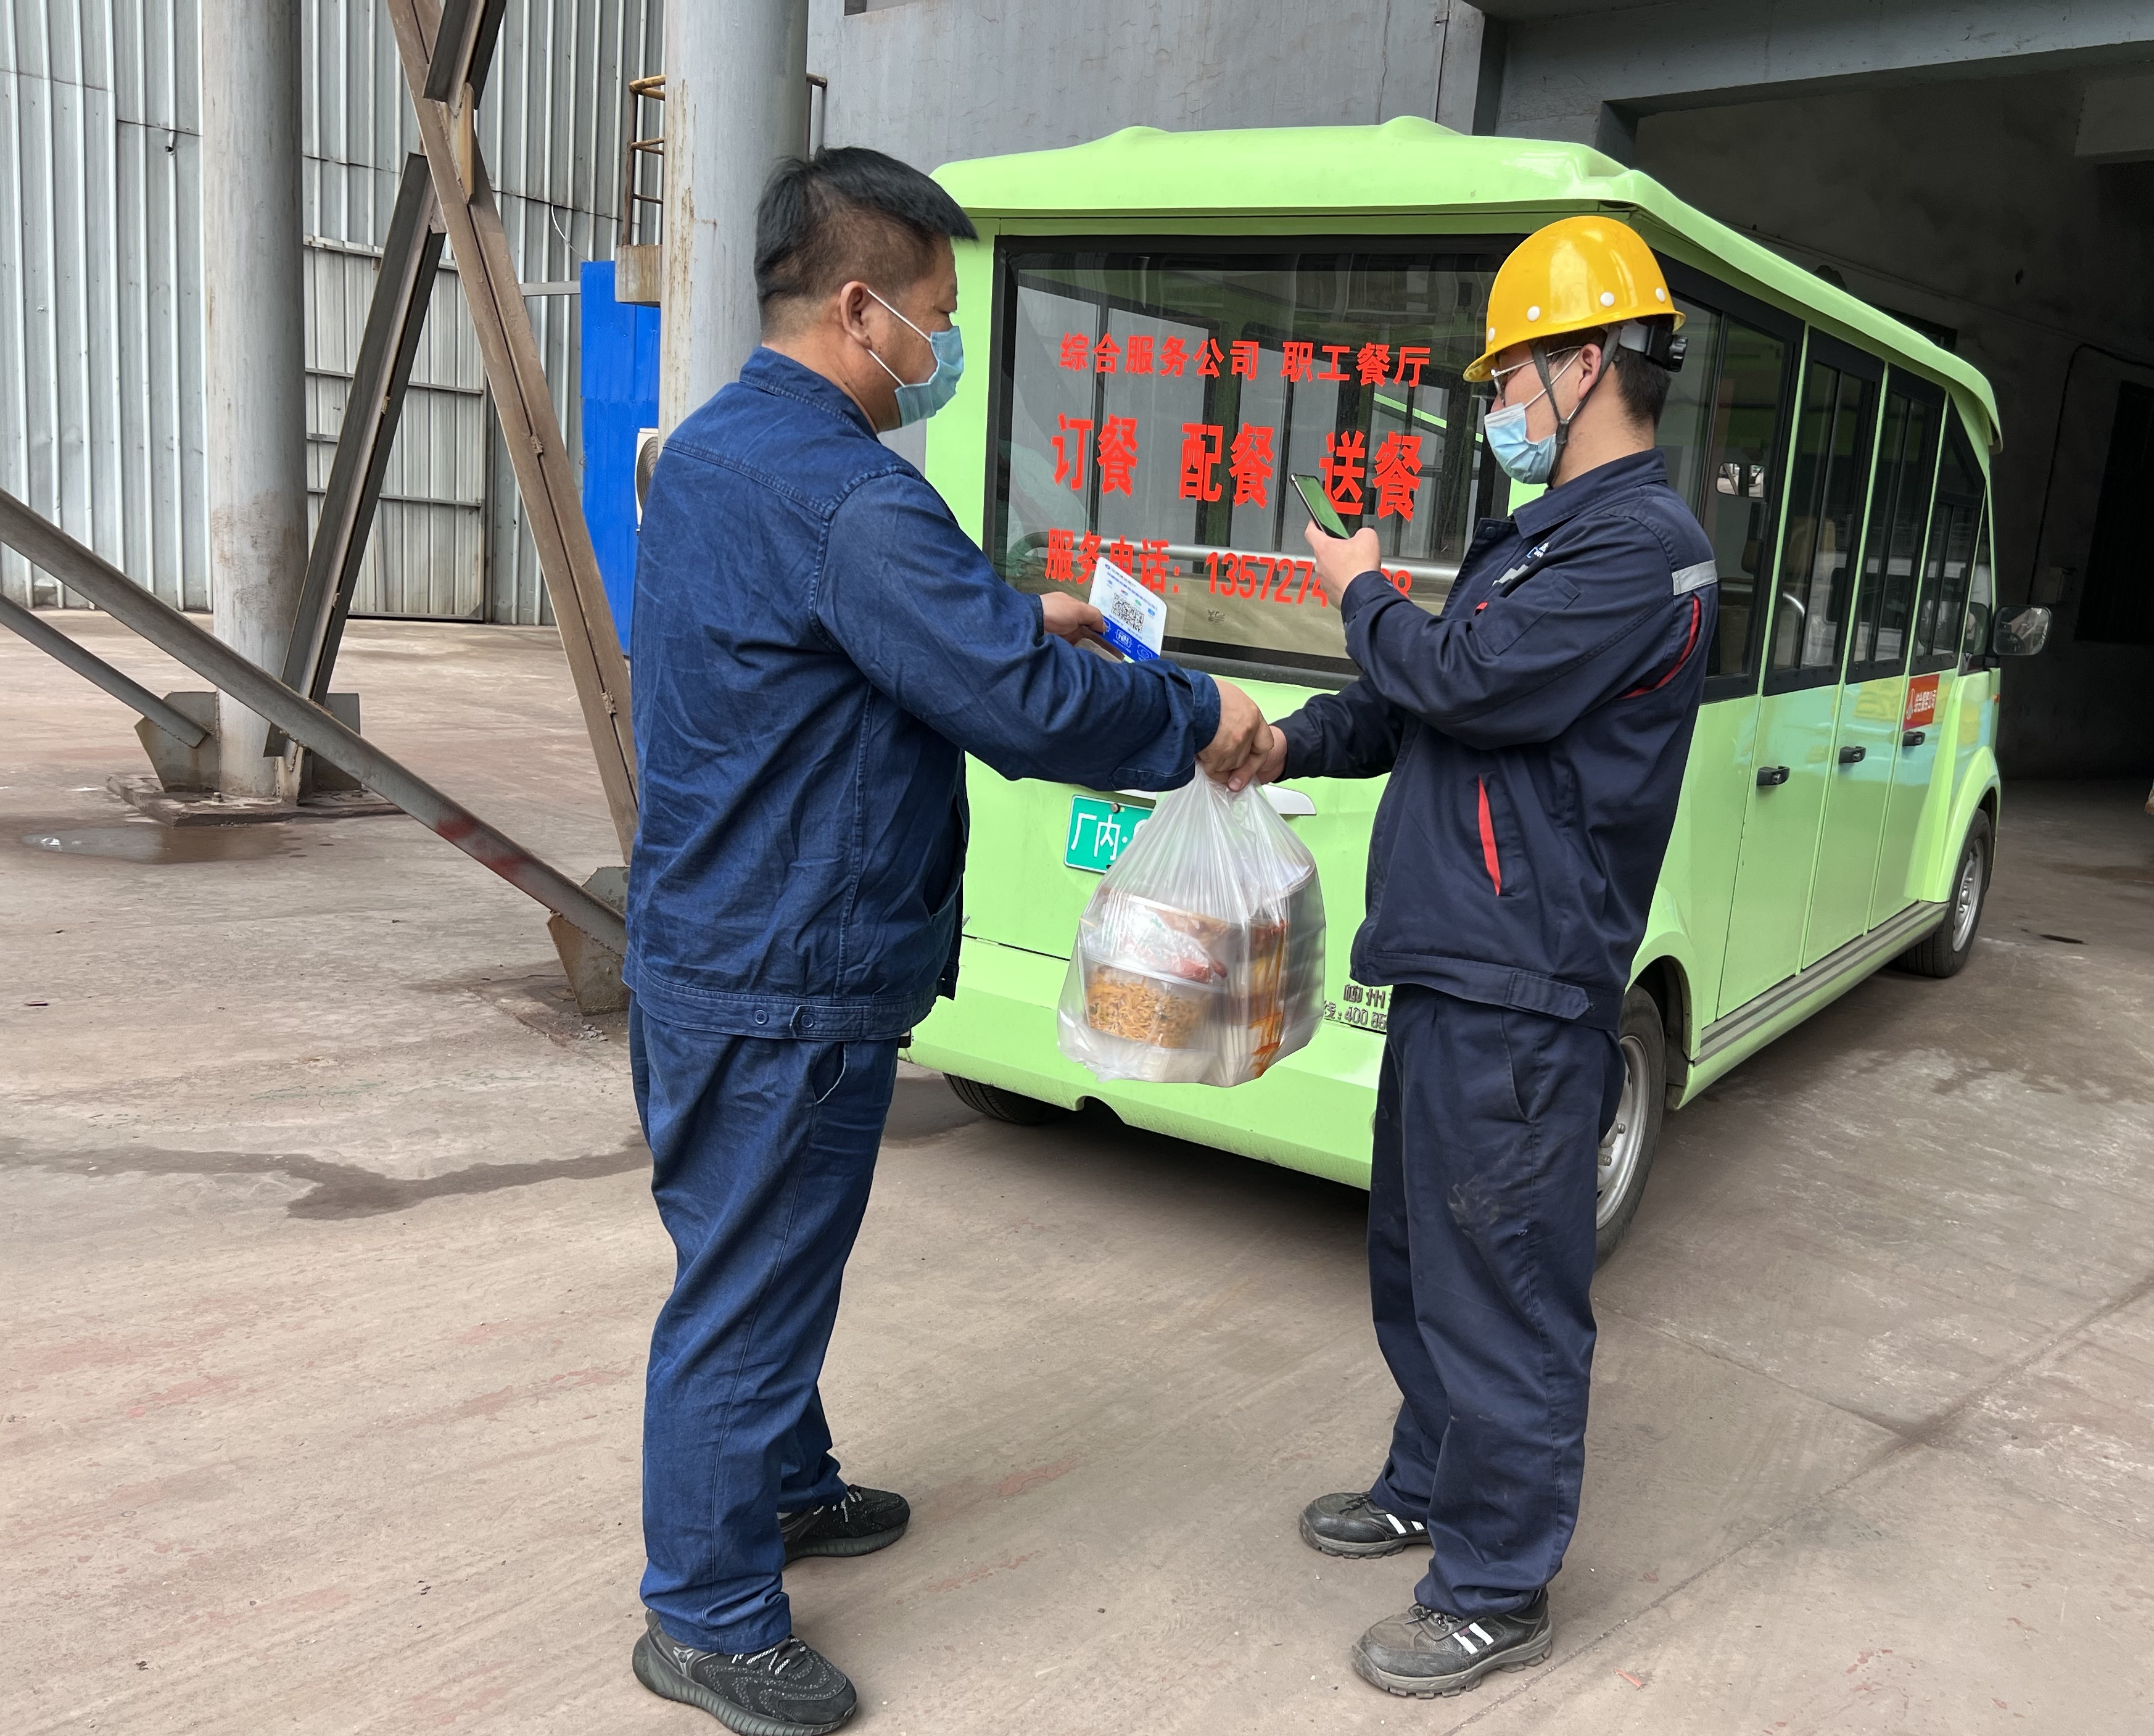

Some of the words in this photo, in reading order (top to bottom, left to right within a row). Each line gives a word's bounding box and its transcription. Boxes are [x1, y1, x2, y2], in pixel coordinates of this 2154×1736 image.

[1059, 333, 1260, 381] 综合服务公司
[1280, 341, 1431, 387] 职工餐厅
[1051, 412, 1139, 497] 订餐
[1179, 423, 1274, 510] 配餐
[1318, 430, 1422, 522] 送餐
[1205, 552, 1413, 608] 13572748
[1343, 984, 1392, 1009] 柳州
[1371, 1012, 1387, 1030] 85
